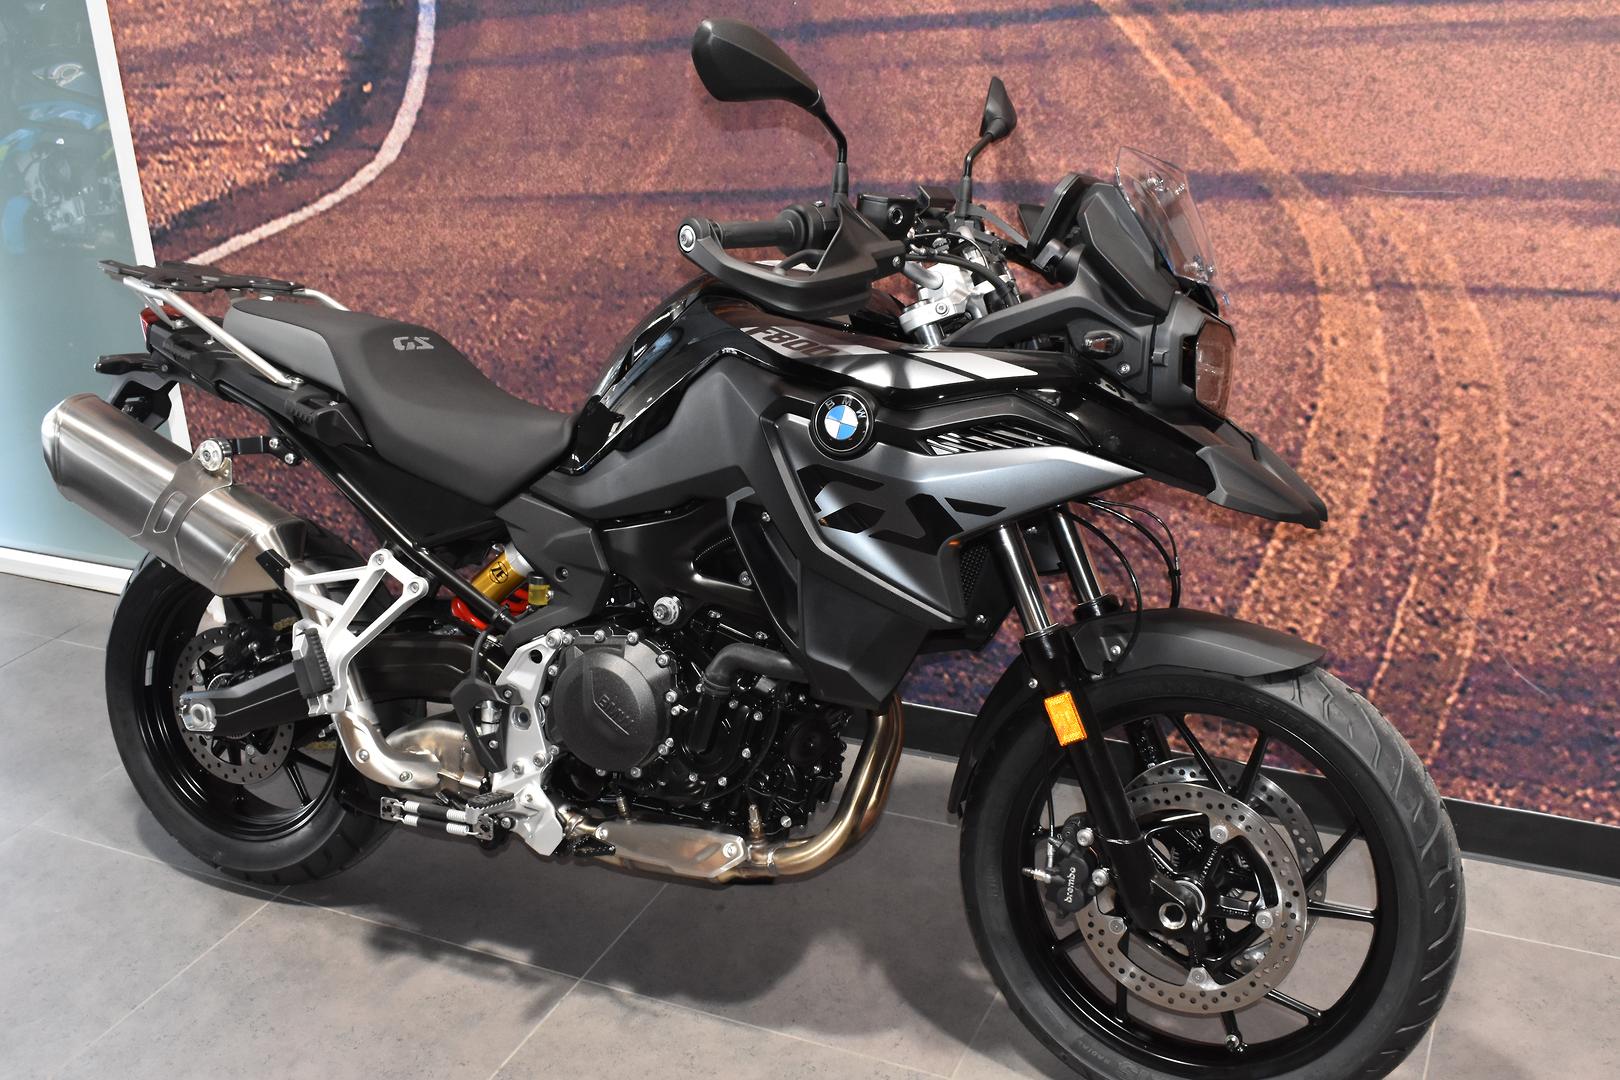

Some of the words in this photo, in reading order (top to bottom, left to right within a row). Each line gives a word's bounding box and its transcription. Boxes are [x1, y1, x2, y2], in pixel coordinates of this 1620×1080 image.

[392, 336, 434, 351] GS
[824, 396, 867, 419] BMW
[490, 562, 509, 584] ZF
[1064, 866, 1077, 904] brembo
